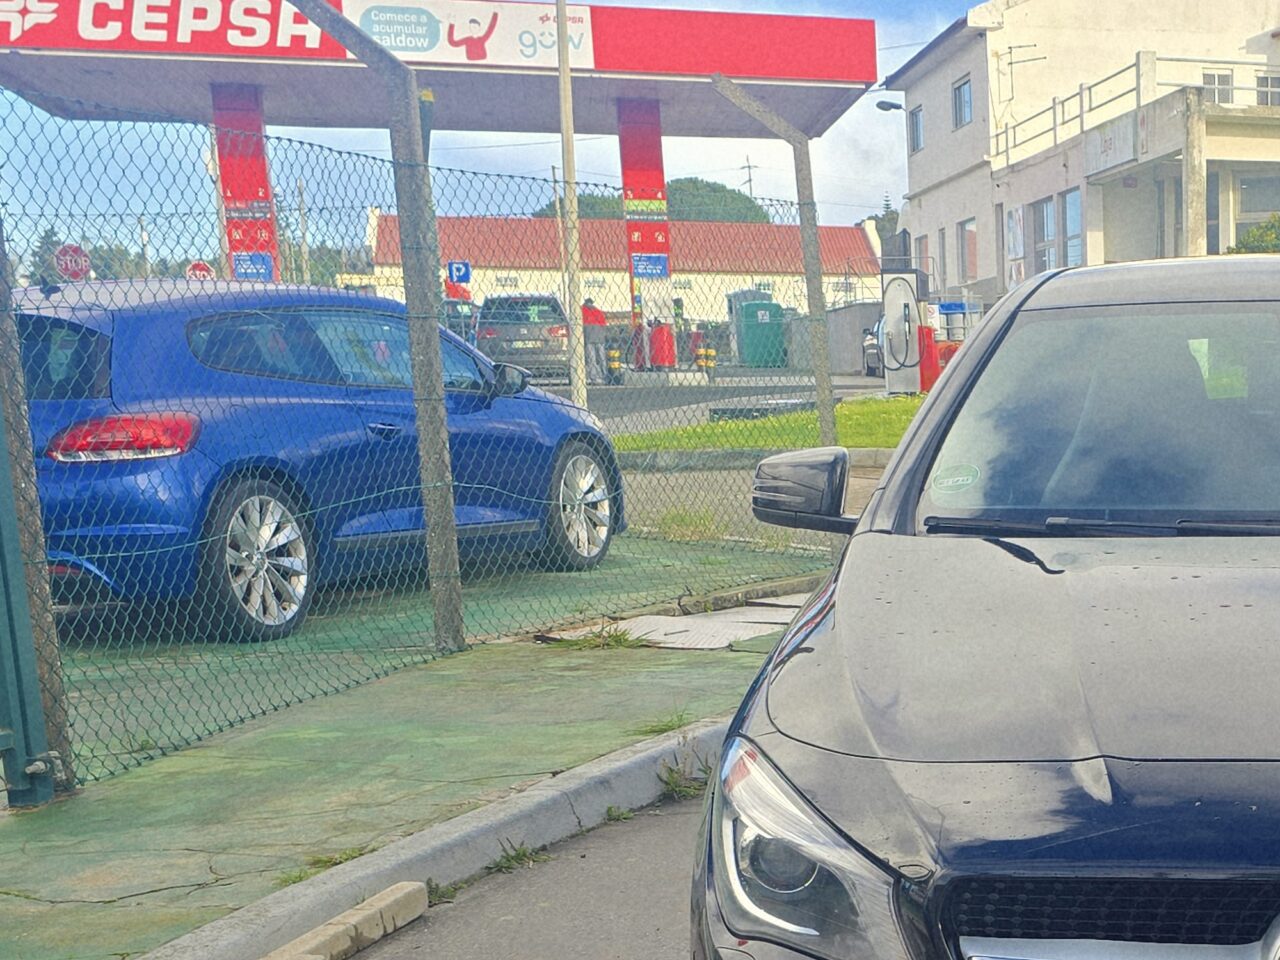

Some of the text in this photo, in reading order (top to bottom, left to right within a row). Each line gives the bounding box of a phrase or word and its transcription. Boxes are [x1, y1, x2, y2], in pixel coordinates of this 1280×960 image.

[371, 10, 427, 23] Comece a
[553, 15, 584, 24] CPSA
[77, 0, 322, 48] CEPSA
[372, 24, 427, 34] acumular
[372, 33, 429, 48] saldow
[59, 256, 90, 270] STOP
[451, 263, 466, 282] P
